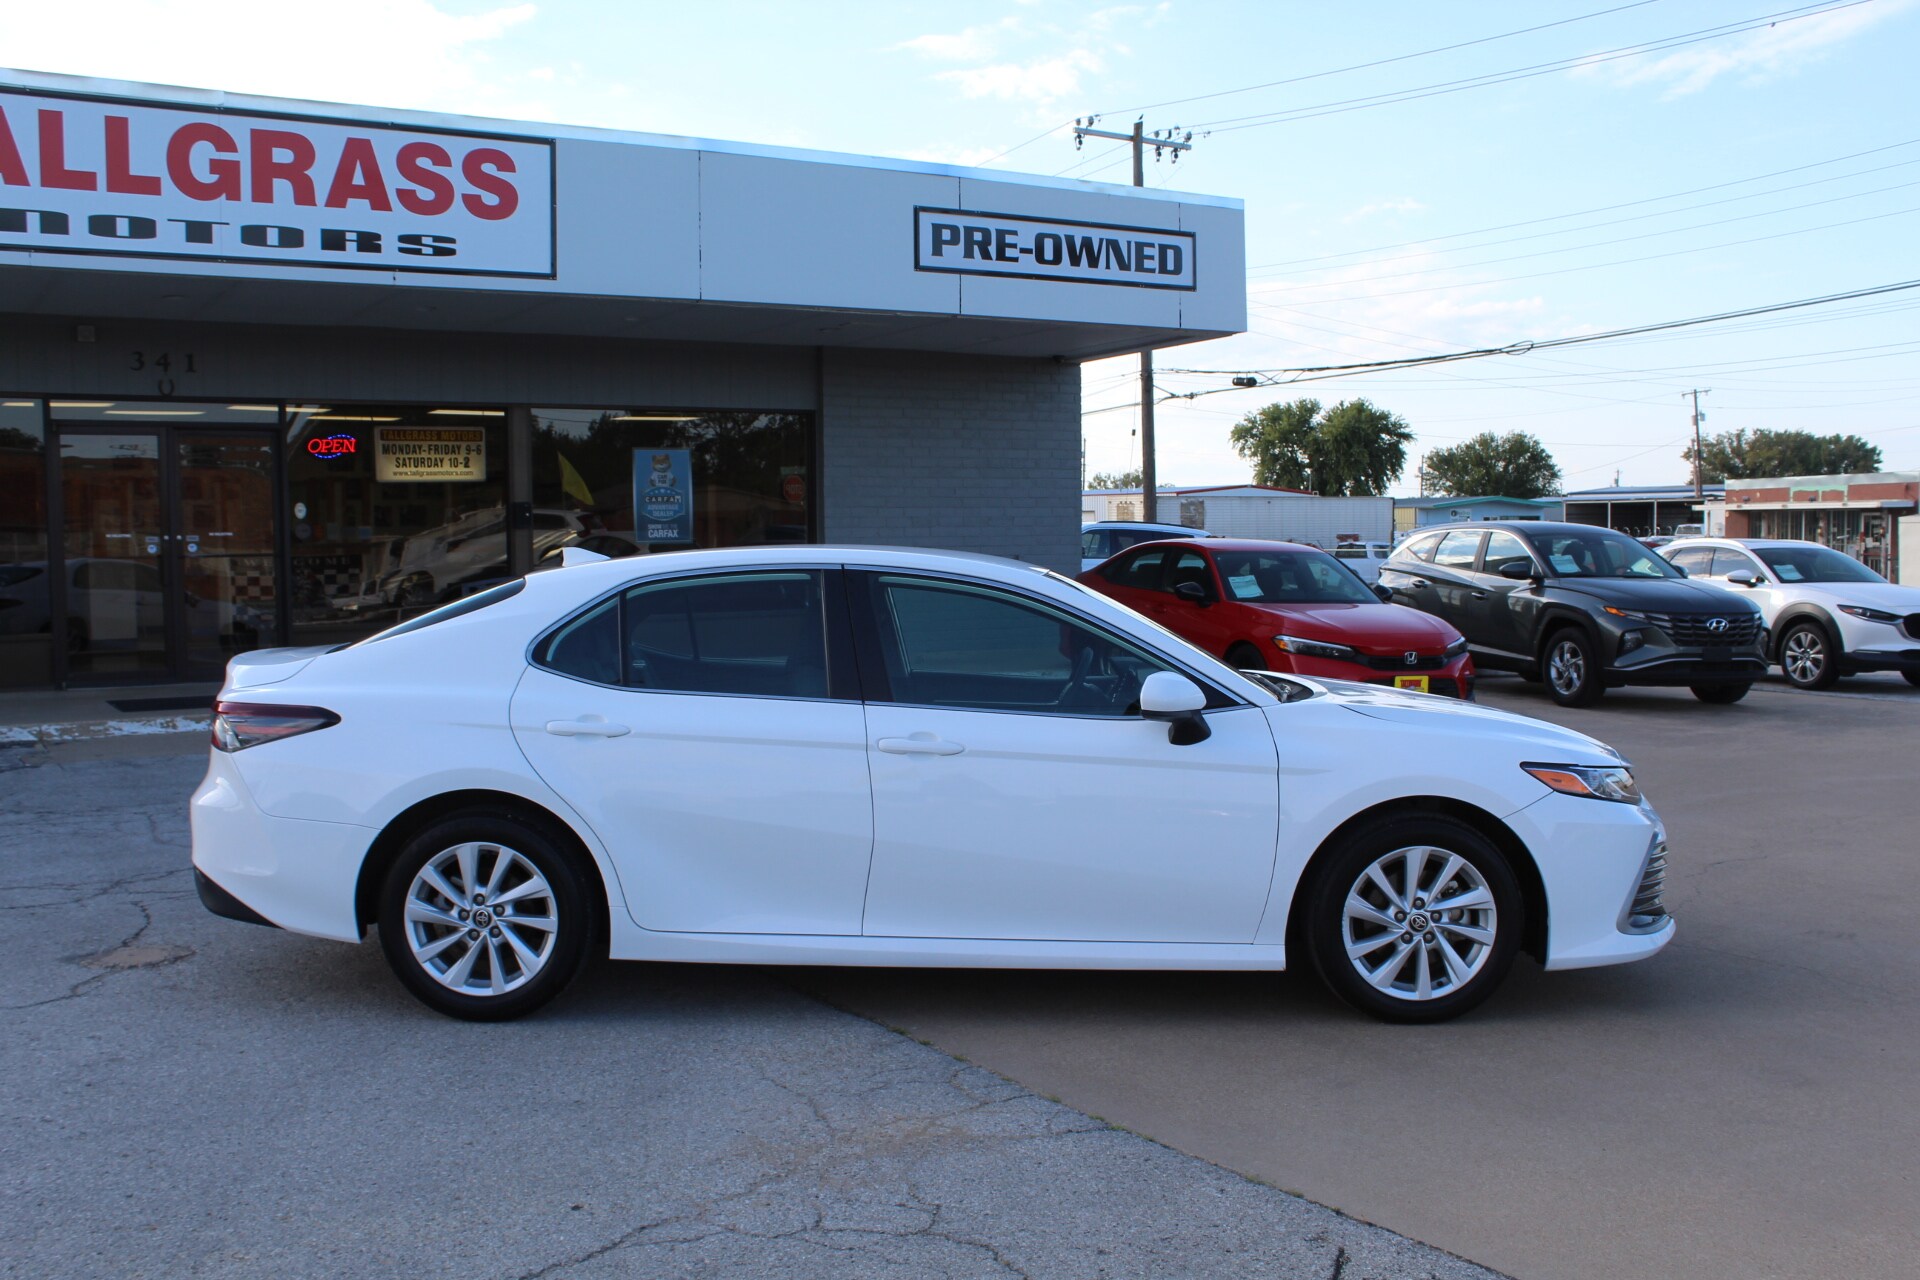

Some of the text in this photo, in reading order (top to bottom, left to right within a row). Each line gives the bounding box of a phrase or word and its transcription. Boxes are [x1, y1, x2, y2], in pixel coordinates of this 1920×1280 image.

[931, 222, 1183, 276] PRE-OWNED
[383, 430, 481, 441] TALLGRASS MOTORS
[307, 438, 356, 453] OPEN
[382, 444, 482, 456] MONDAY-FRIDAY 9-6
[395, 456, 471, 468] SATURDAY 10-2
[648, 529, 679, 538] CARFAX
